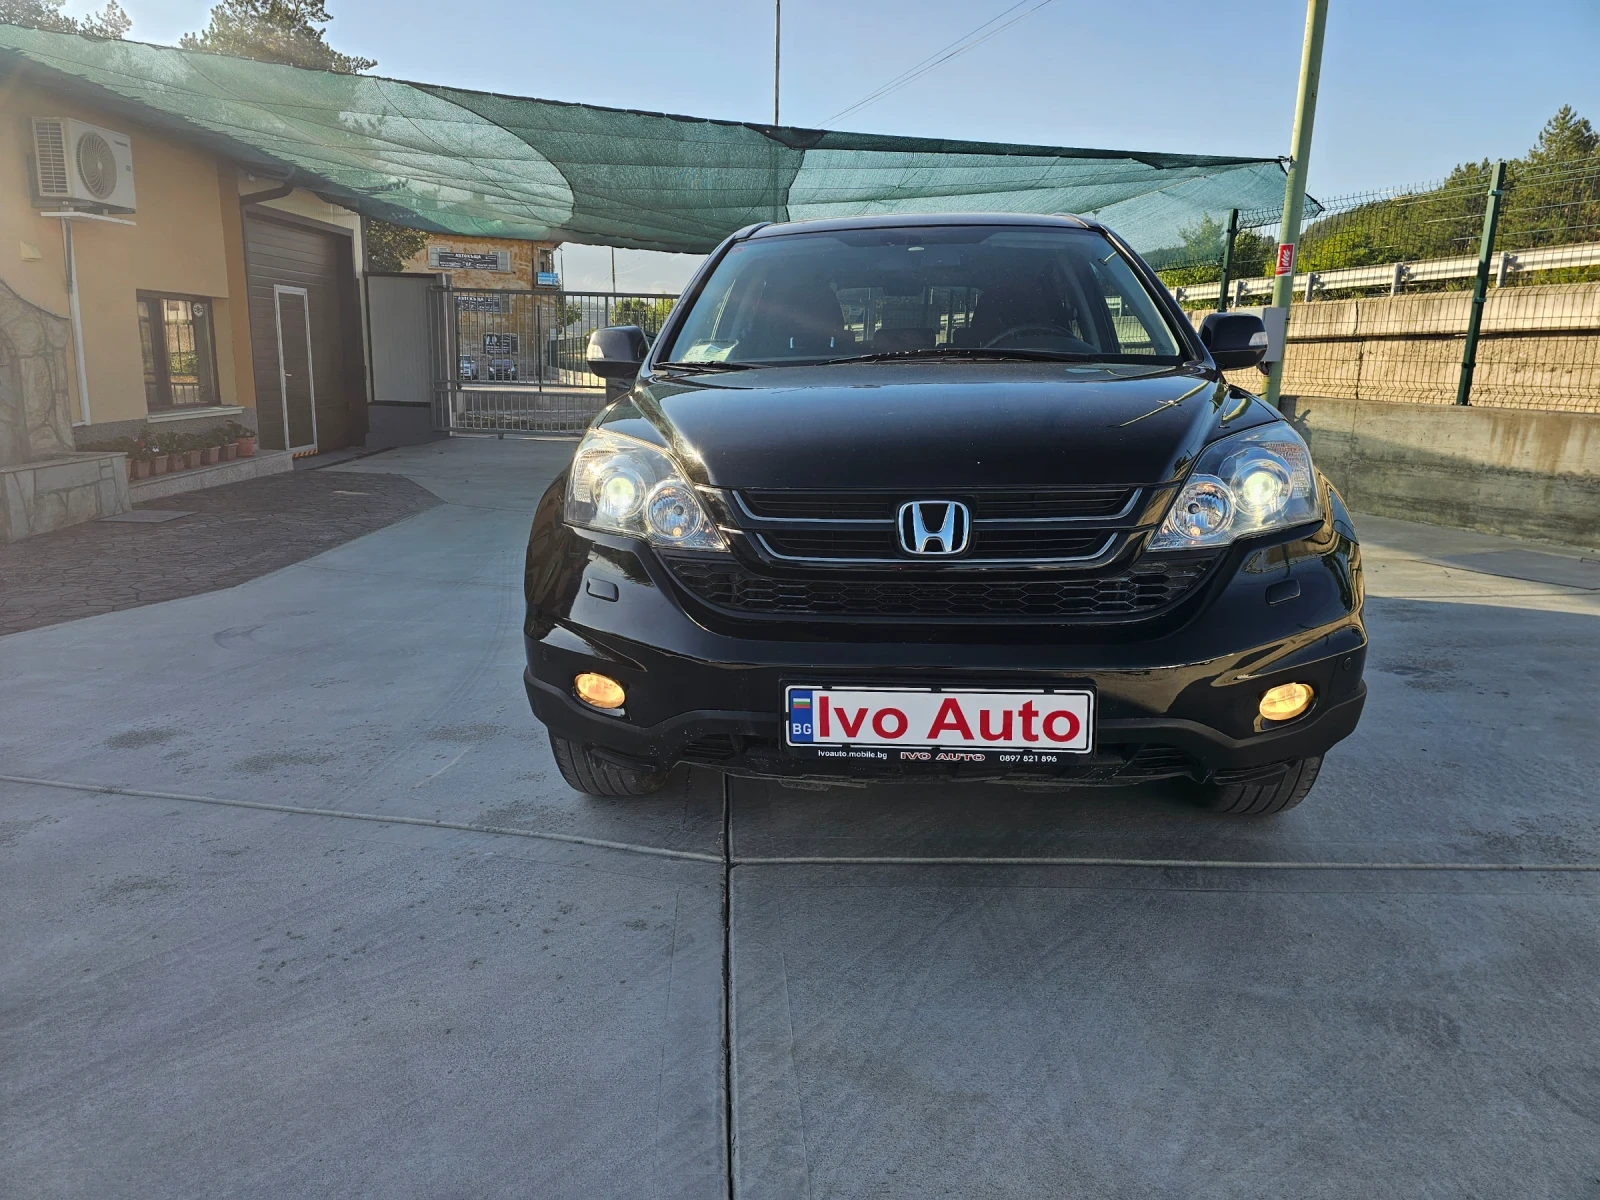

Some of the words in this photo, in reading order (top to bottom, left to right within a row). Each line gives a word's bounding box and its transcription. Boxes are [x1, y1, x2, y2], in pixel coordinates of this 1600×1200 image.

[818, 695, 908, 740] Ivo
[926, 697, 1081, 743] Auto
[792, 723, 812, 735] BG
[900, 751, 931, 761] IVO
[935, 752, 986, 762] AUTO
[999, 754, 1021, 763] 0897
[1023, 754, 1038, 763] 821
[1040, 755, 1058, 763] 896
